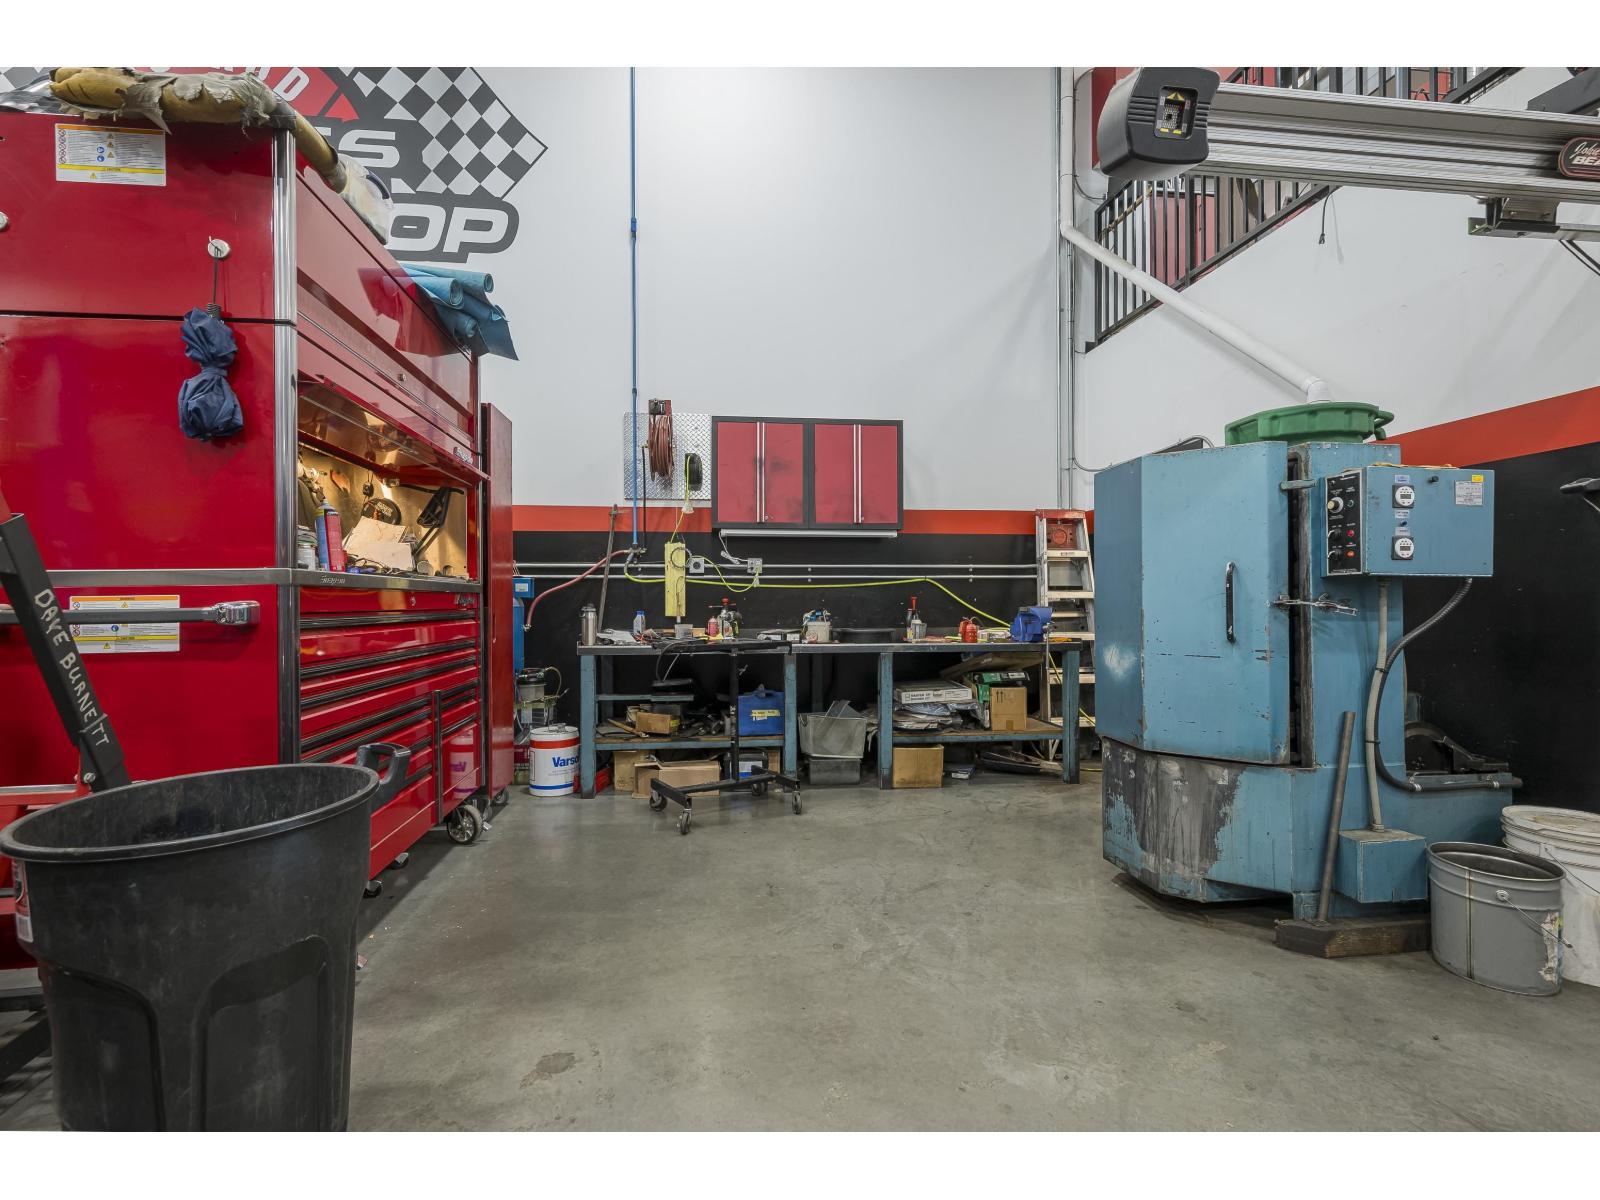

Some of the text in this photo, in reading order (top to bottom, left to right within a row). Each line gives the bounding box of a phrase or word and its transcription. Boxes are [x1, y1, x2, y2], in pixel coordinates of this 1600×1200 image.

[384, 202, 509, 253] OP
[60, 652, 110, 747] BURNETT
[552, 755, 579, 768] Varso
